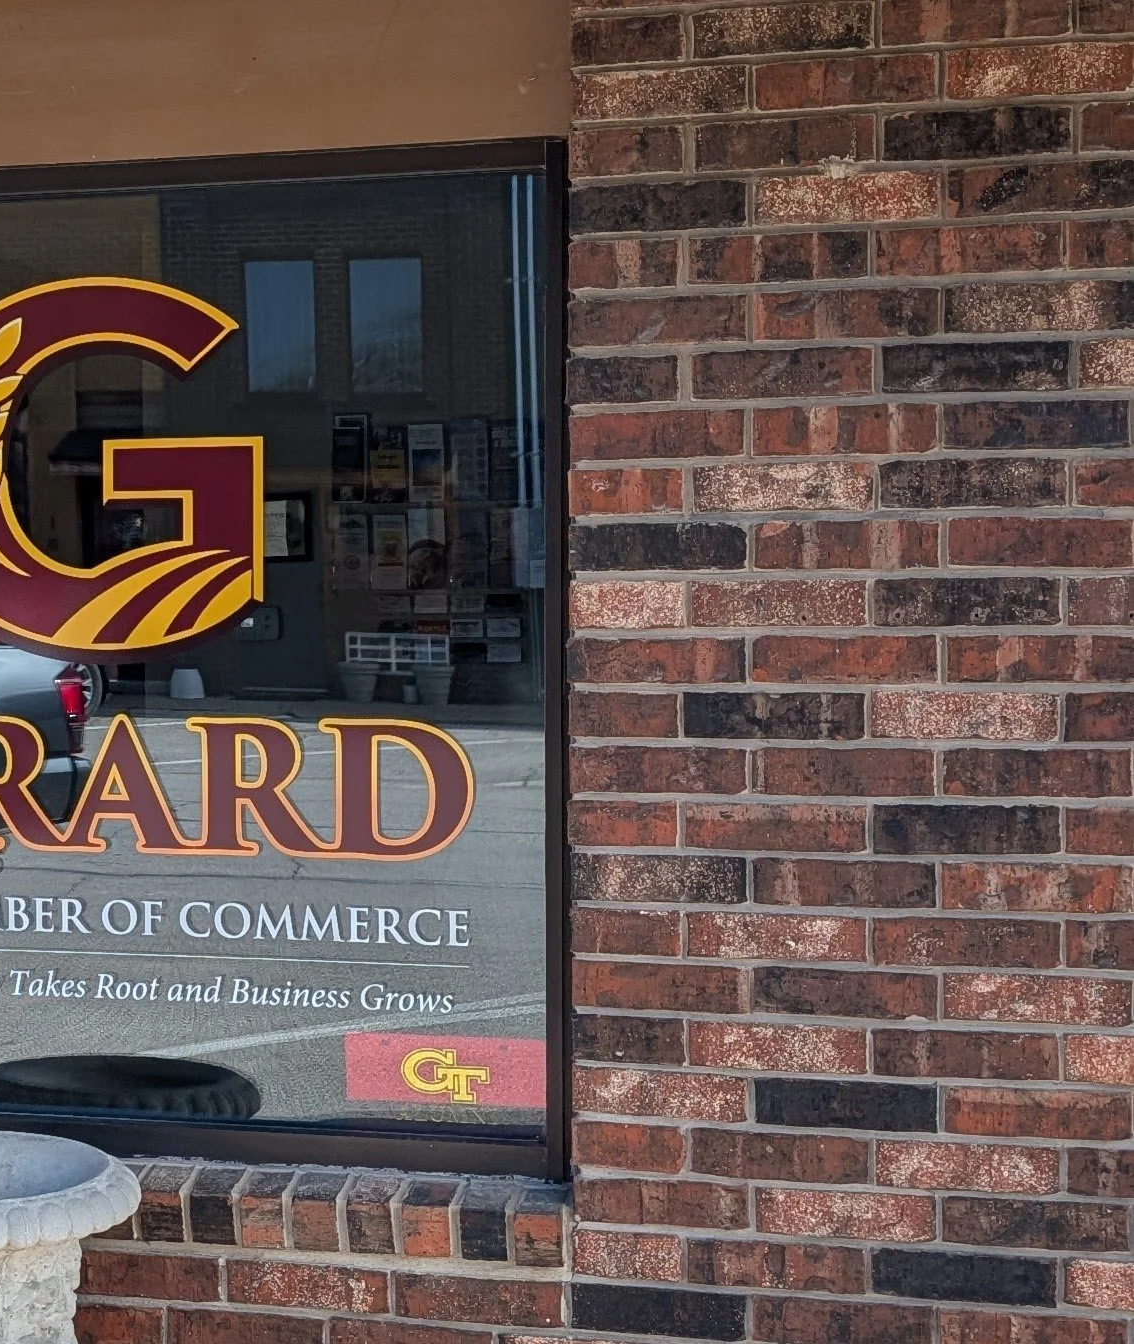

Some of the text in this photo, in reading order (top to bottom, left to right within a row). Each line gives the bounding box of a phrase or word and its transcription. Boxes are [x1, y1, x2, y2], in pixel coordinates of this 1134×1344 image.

[101, 899, 164, 936] OF
[179, 901, 470, 947] COMMERCE
[10, 969, 86, 998] Takes
[94, 973, 159, 1001] Root
[167, 976, 223, 1004] and
[229, 978, 350, 1009] Business
[360, 983, 454, 1014] Grows
[400, 1047, 491, 1104] GT
